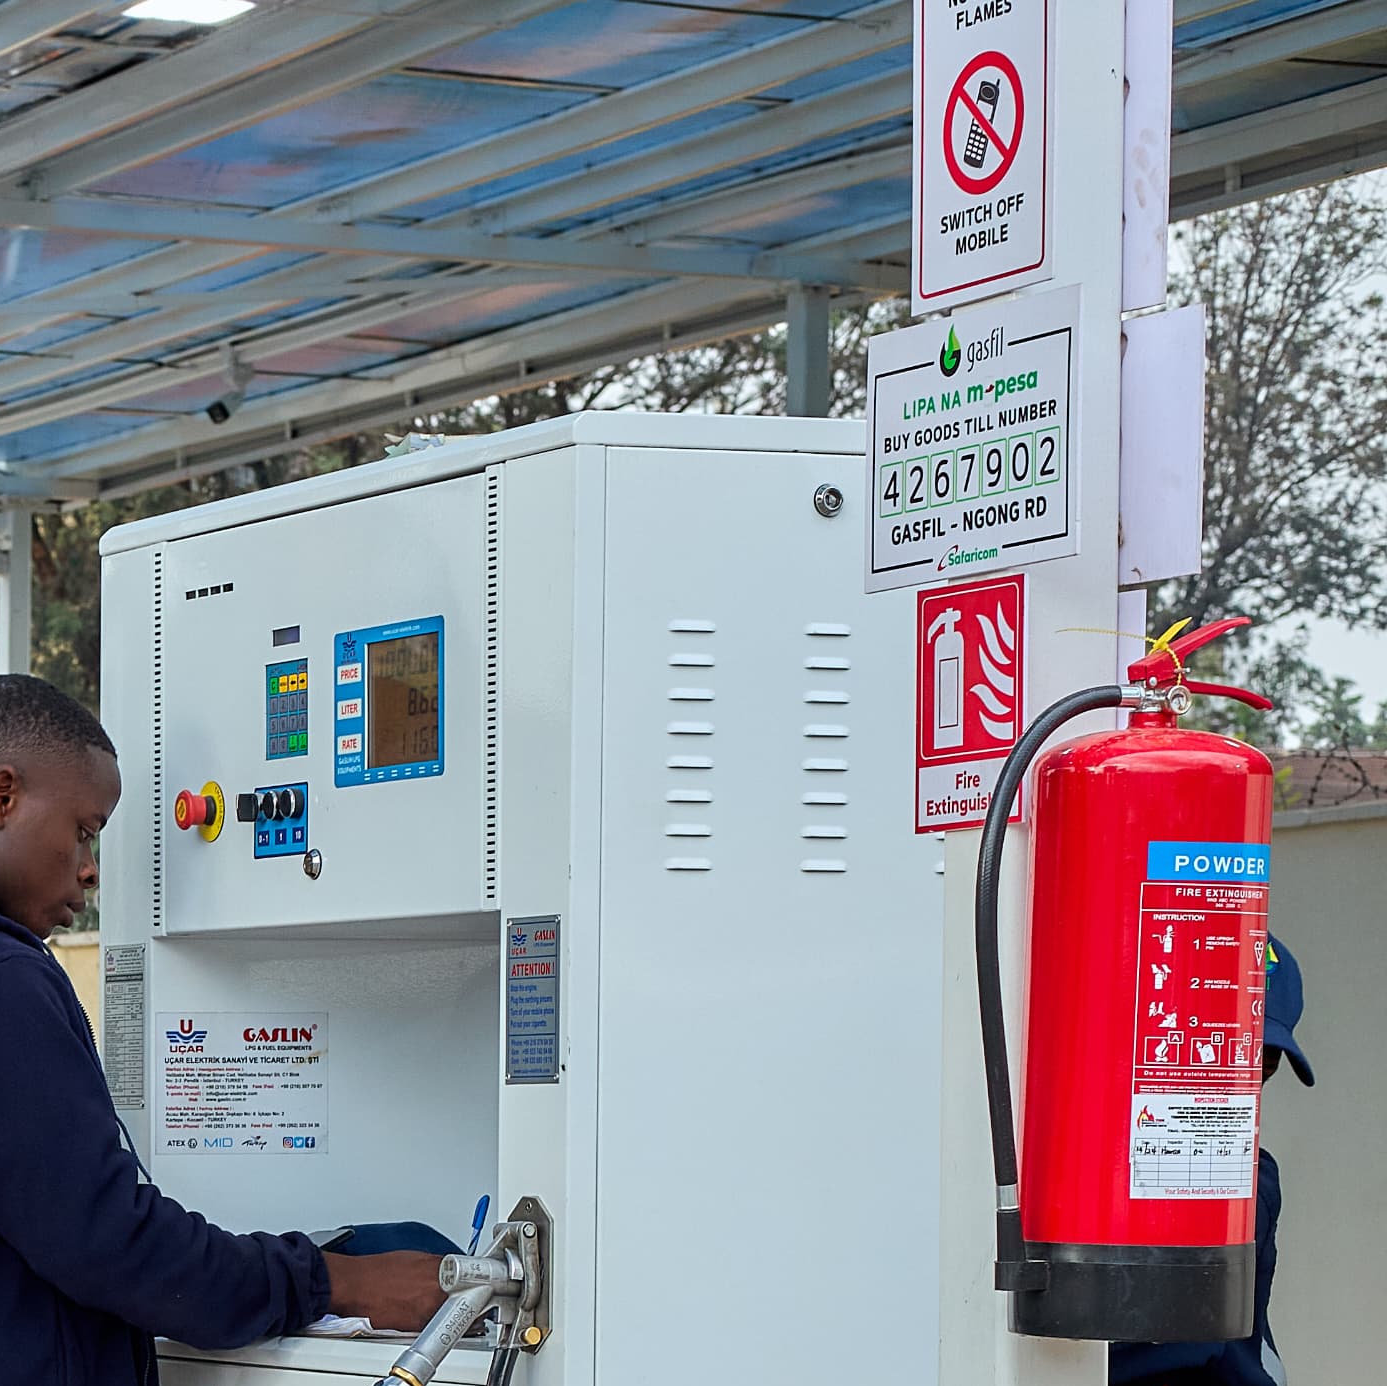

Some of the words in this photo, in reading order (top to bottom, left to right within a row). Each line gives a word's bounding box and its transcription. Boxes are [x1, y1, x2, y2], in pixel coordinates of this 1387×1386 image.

[957, 0, 1011, 30] FLAMES
[941, 203, 992, 234] SWITCH
[997, 193, 1024, 217] OFF
[956, 224, 1008, 255] MOBILE
[967, 327, 1004, 372] gasfil
[903, 397, 935, 420] LIPA
[941, 390, 961, 411] NA
[884, 433, 910, 453] BUY
[915, 422, 959, 446] GOODS
[965, 415, 993, 435] TILL
[999, 399, 1057, 428] NUMBER
[884, 437, 1055, 507] 4267902
[892, 518, 945, 545] GASFIL
[963, 502, 1019, 531] NGONG
[1025, 496, 1047, 519] RD
[949, 548, 998, 566] Safaricom
[341, 668, 358, 681] PRICE
[341, 703, 357, 715] LITER
[342, 739, 357, 750] RATE
[955, 772, 981, 790] Fire
[926, 792, 993, 817] Extinguis
[1175, 856, 1264, 875] POWDER
[1176, 888, 1201, 897] FIRE
[1206, 889, 1263, 899] EXTINGUISHER
[1153, 914, 1205, 922] INSTRUCTION
[1193, 939, 1200, 950] 1
[511, 963, 550, 977] ATTENTION
[1190, 978, 1200, 989] 2
[1189, 1016, 1198, 1027] 3
[243, 1027, 313, 1043] GASLIN
[1172, 1034, 1180, 1042] A
[170, 1045, 203, 1055] UÇAR
[165, 1057, 184, 1065] UÇAR
[204, 1138, 233, 1147] MID
